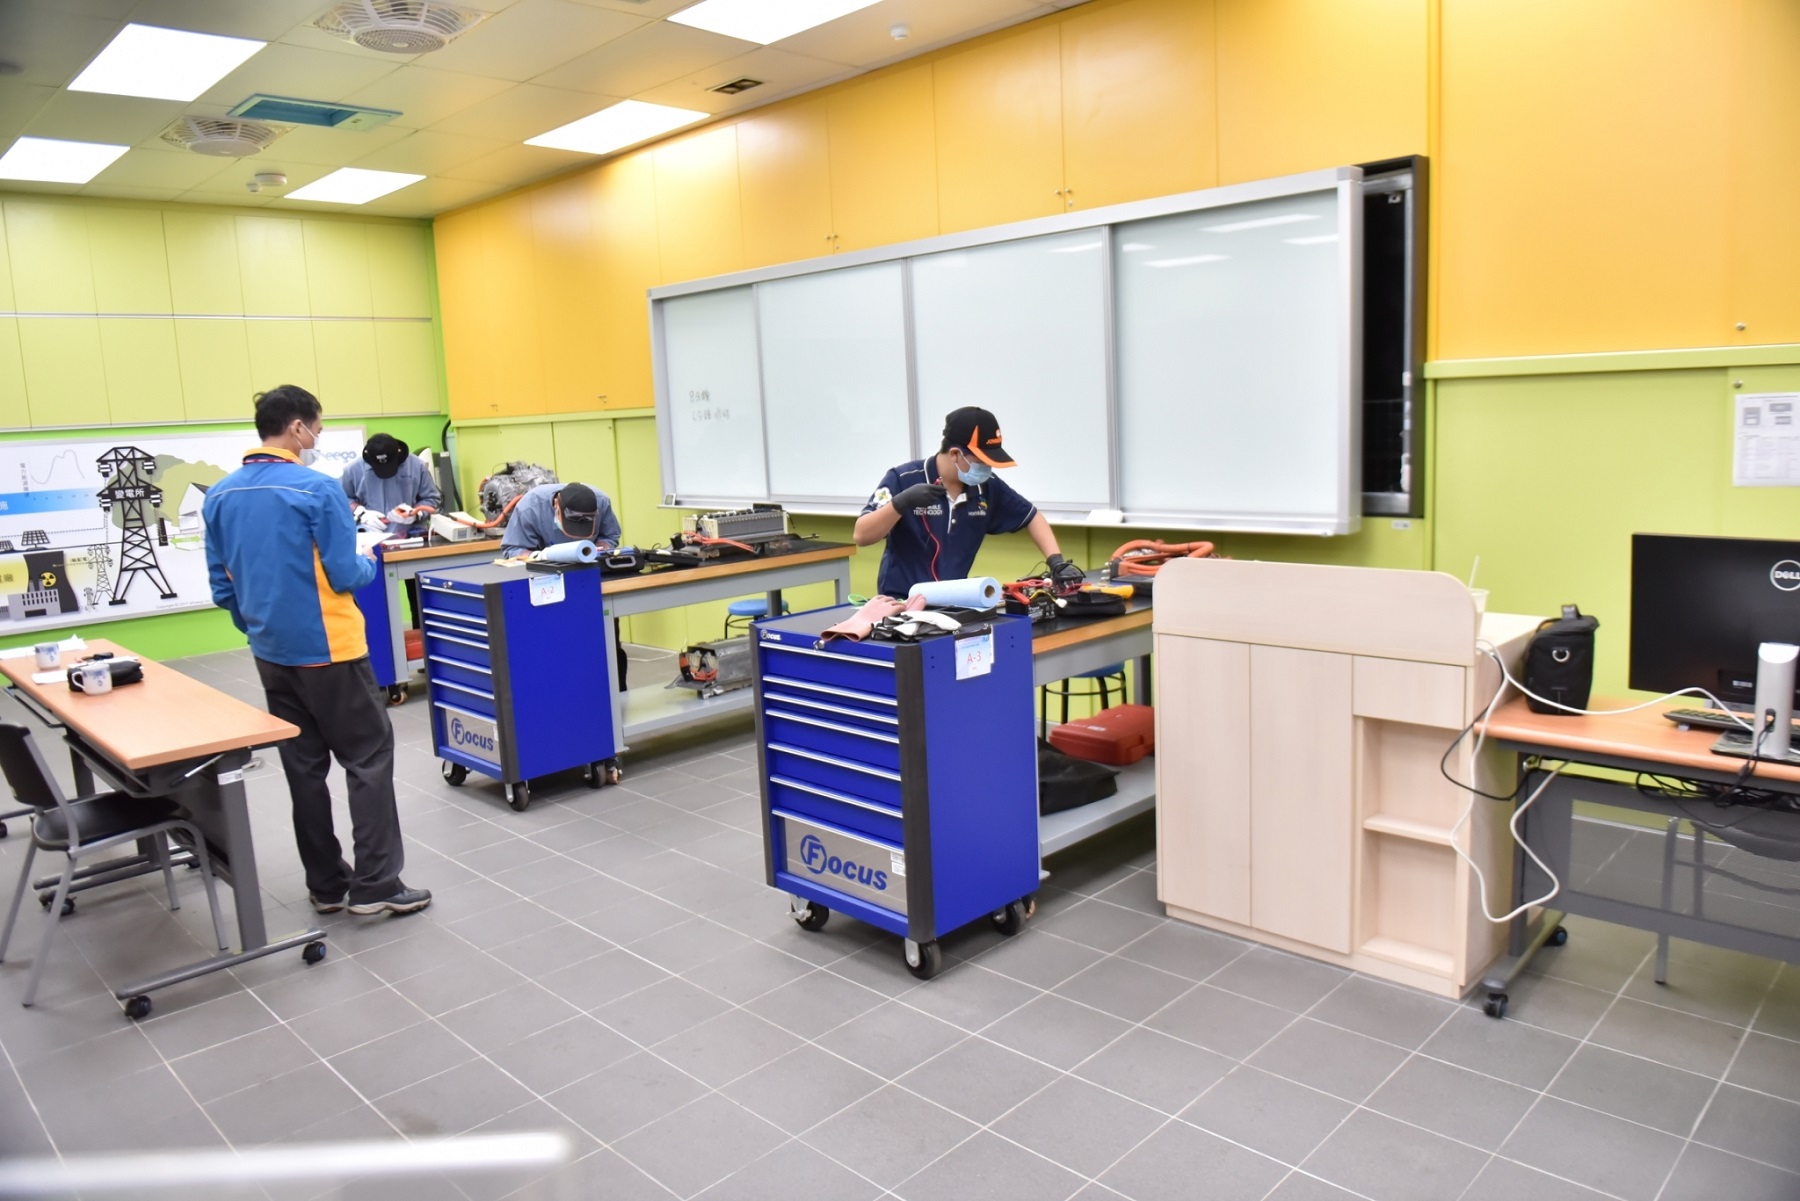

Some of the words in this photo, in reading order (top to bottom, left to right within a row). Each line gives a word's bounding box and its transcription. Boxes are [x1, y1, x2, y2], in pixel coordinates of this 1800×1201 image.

[114, 487, 146, 500] 變電所
[966, 650, 982, 665] A-3
